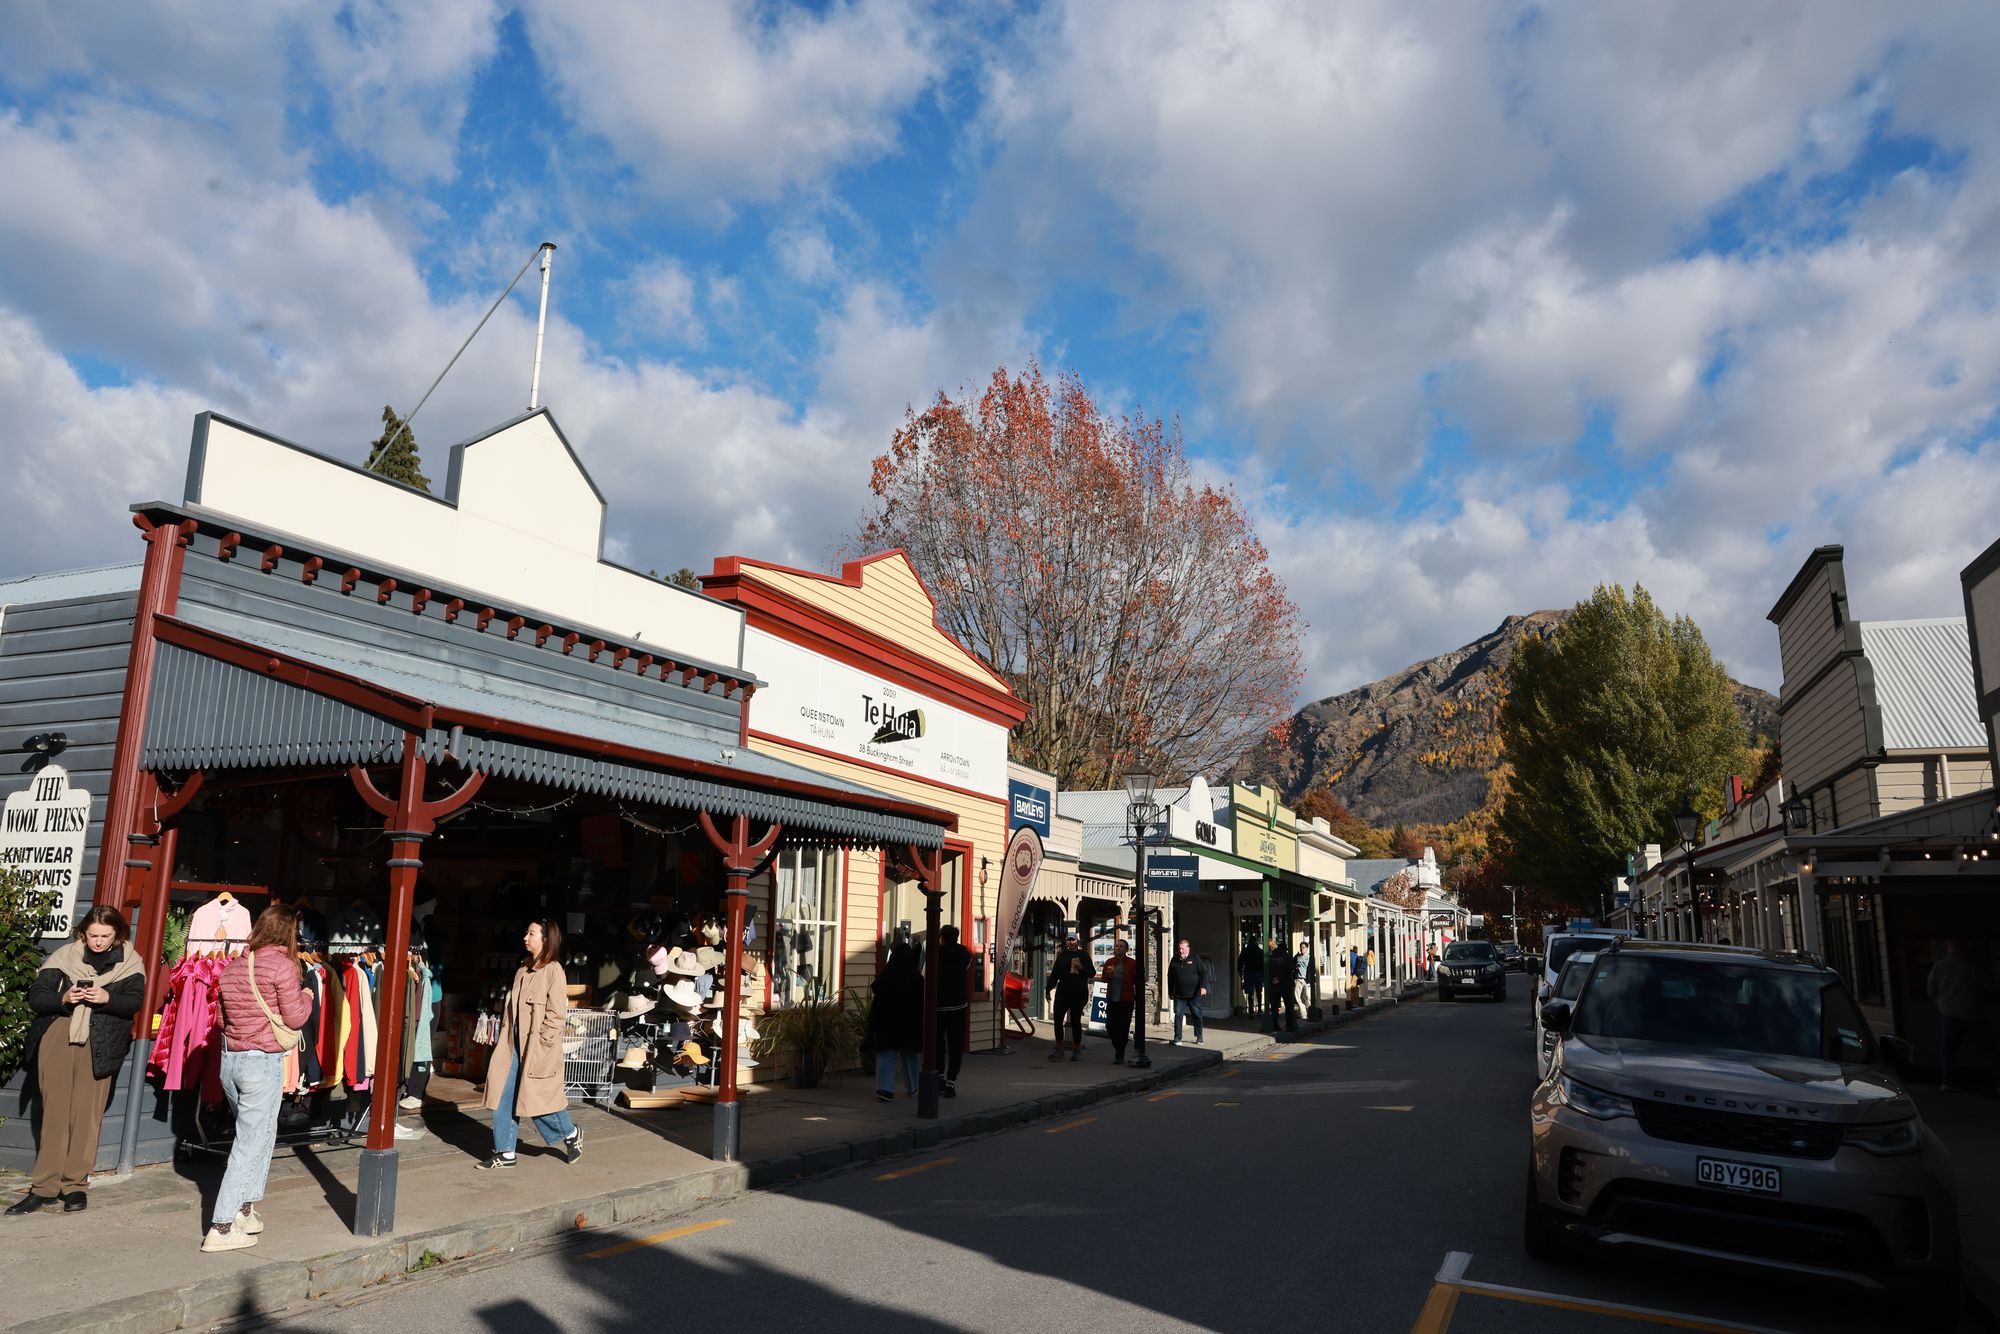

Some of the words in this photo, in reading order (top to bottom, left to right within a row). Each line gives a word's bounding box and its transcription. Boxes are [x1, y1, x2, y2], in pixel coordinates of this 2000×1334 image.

[800, 706, 845, 728] QUEENSTOWN
[862, 694, 879, 725] Te
[883, 702, 916, 738] Huia
[867, 745, 898, 762] Buckingham
[899, 755, 914, 767] Street
[35, 777, 64, 801] THE
[7, 808, 39, 832] WOOL
[43, 806, 86, 832] PRESS
[1016, 799, 1043, 819] BAYLEYS
[3, 846, 73, 863] KNITWEAR
[1011, 890, 1026, 929] GOOSE
[1654, 1090, 1819, 1115] DISCOVERY
[1701, 1162, 1777, 1189] QBY906
